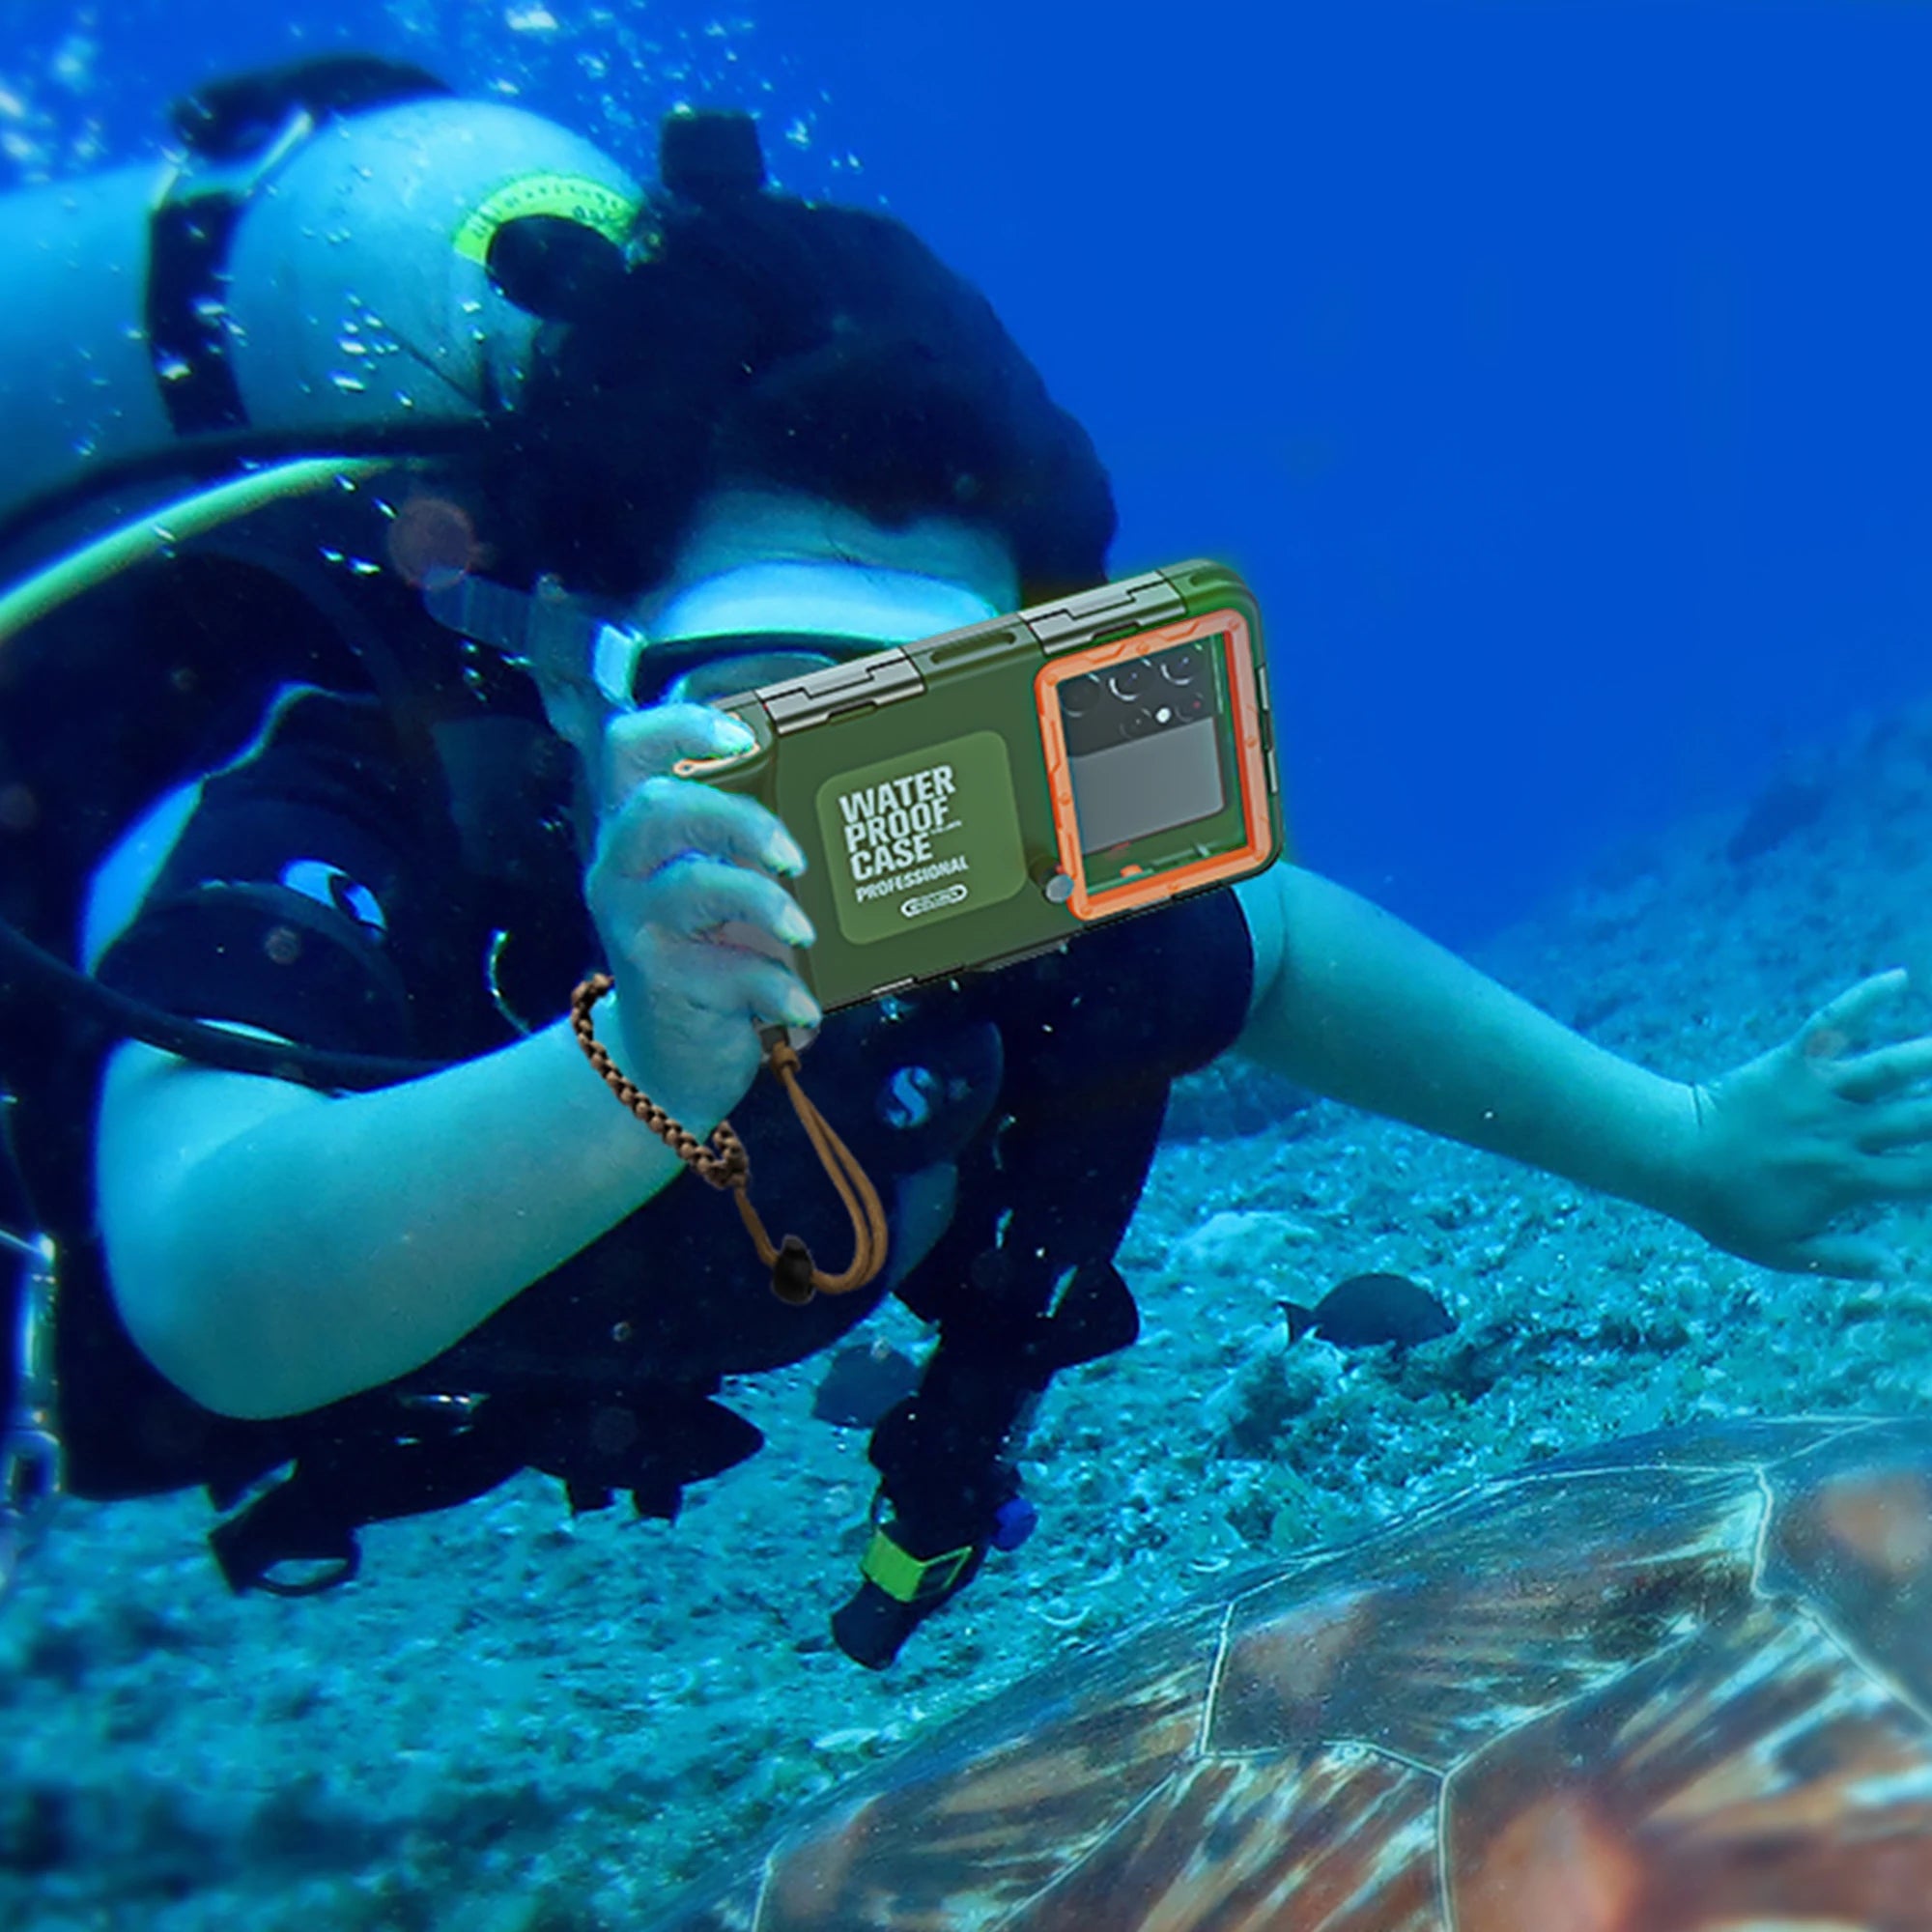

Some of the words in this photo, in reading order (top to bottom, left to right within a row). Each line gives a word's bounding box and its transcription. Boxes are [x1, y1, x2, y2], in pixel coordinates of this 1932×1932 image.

[838, 765, 956, 823] WATER
[844, 795, 950, 853] PROOF
[850, 832, 933, 882] CASE
[855, 855, 969, 903] PROFESSIONAL
